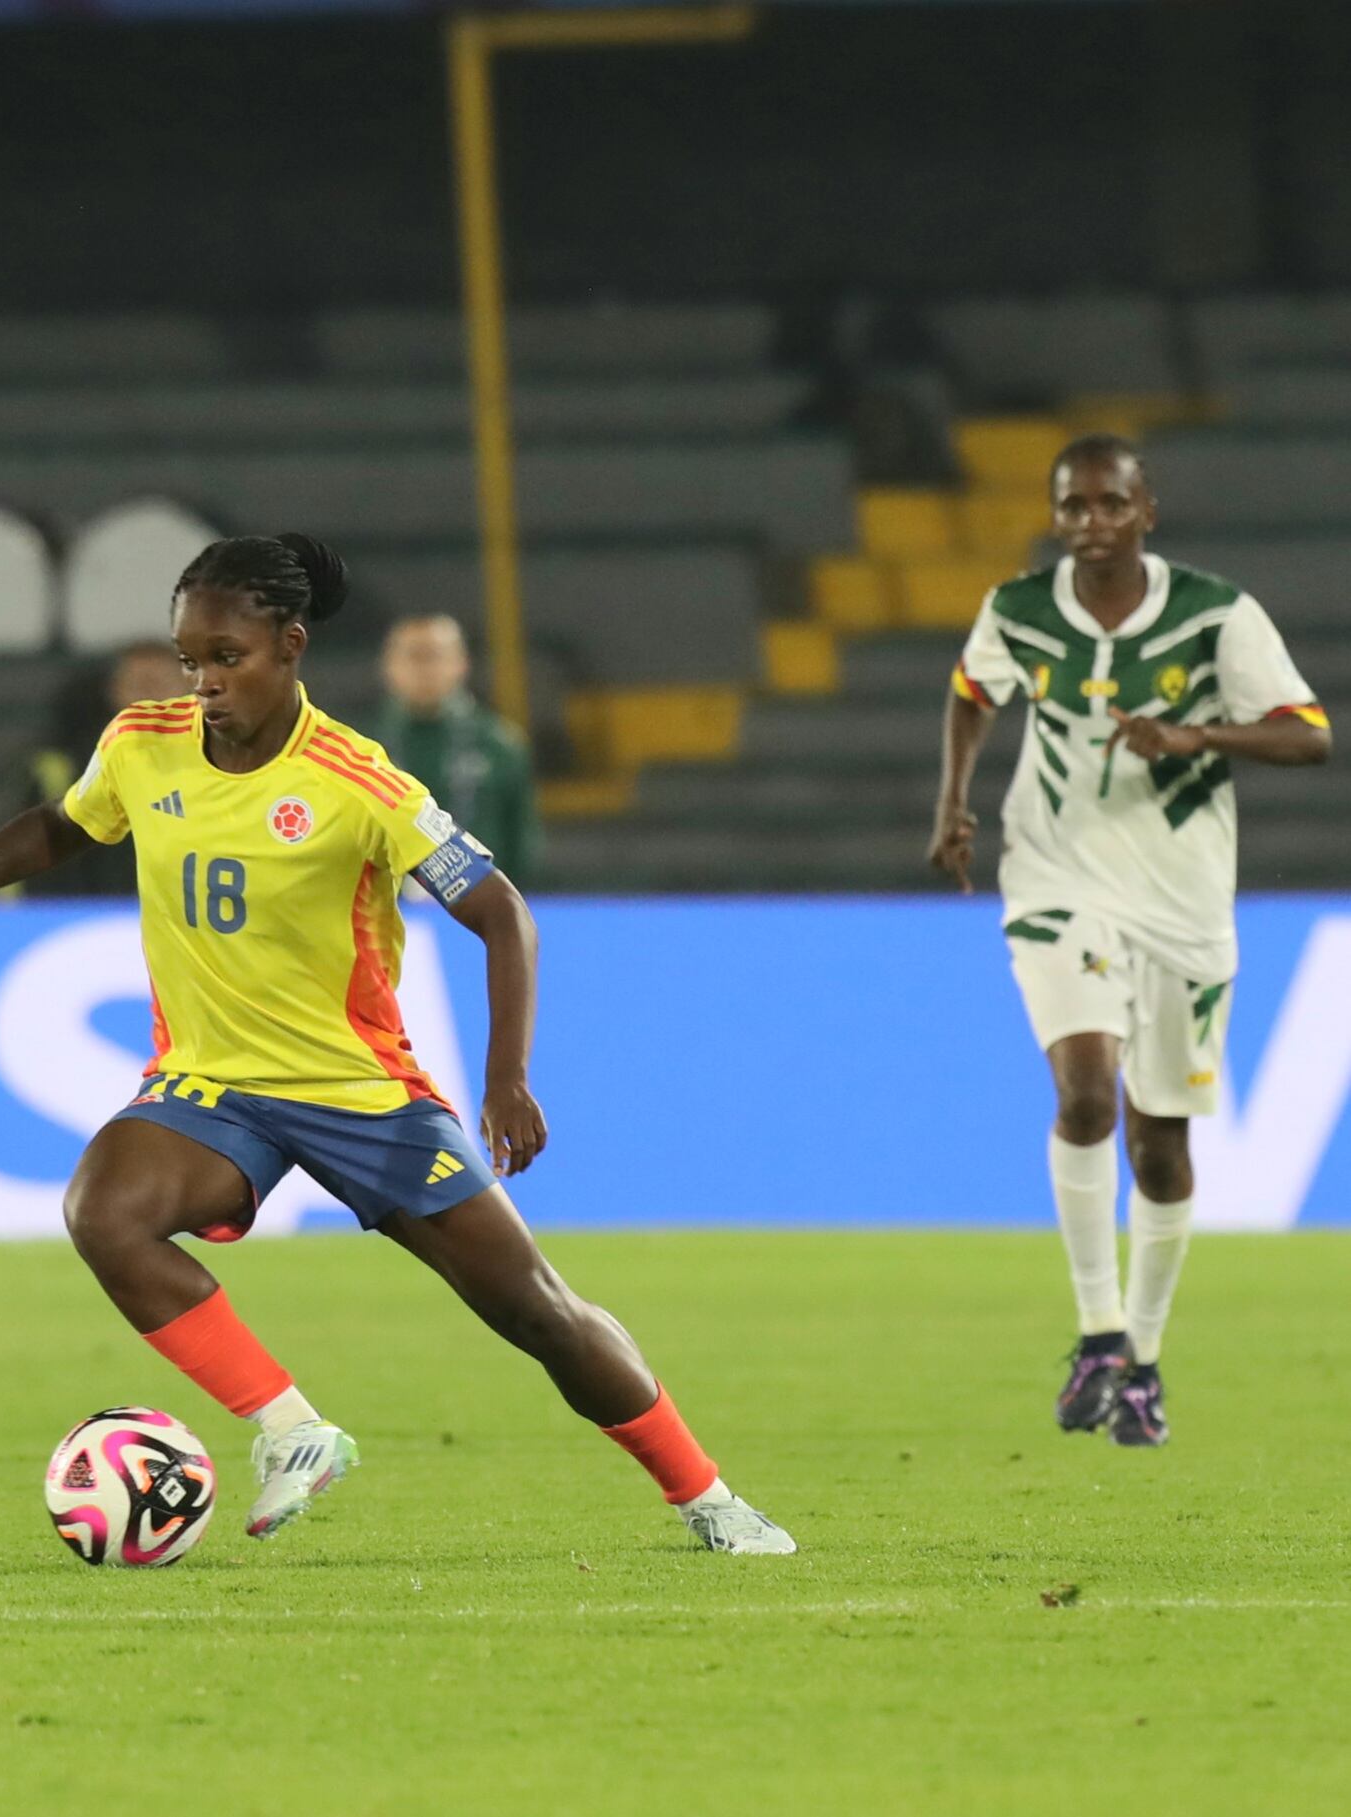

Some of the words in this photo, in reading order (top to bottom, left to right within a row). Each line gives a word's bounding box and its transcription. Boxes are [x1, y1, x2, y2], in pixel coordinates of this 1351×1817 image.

[424, 848, 466, 882] UNITES
[183, 852, 247, 935] 18
[445, 881, 464, 898] FIFA
